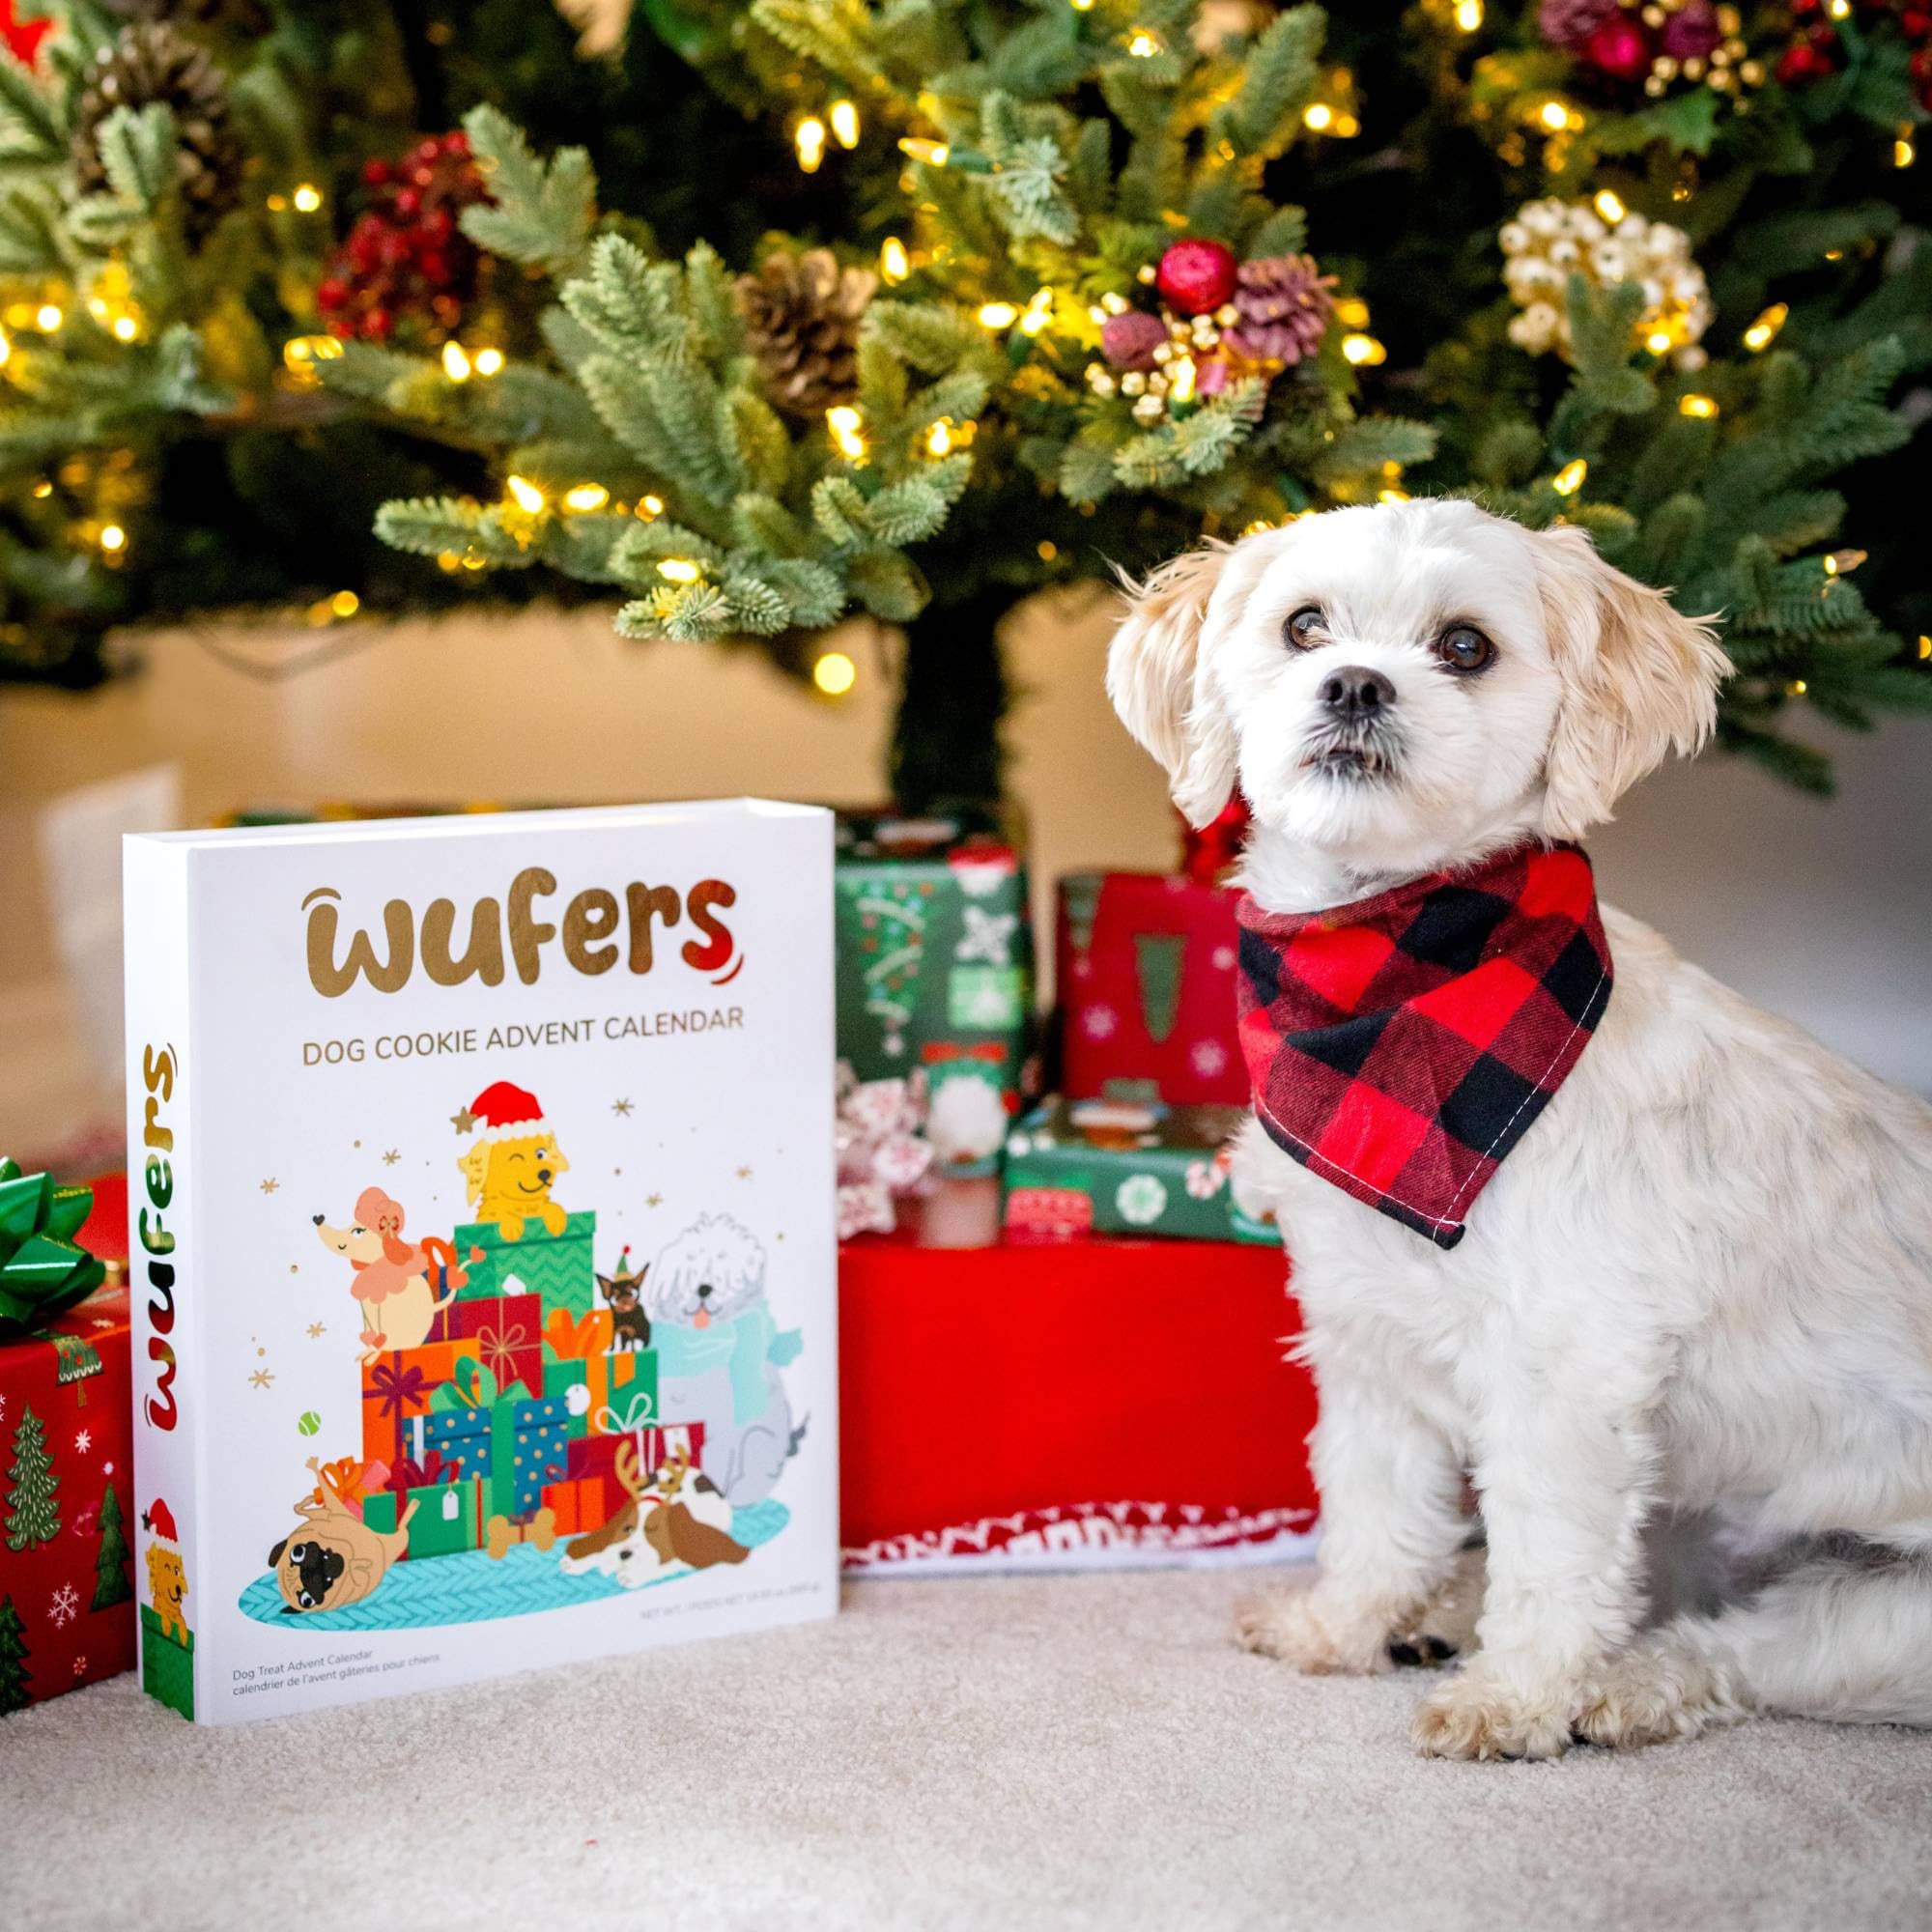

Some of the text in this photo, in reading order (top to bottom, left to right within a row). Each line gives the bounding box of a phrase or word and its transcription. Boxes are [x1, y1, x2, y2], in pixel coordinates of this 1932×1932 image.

[302, 867, 743, 998] wufers
[302, 1007, 744, 1065] DOG COOKIE ADVENT CALENDAR
[139, 1042, 178, 1432] wufers
[233, 1649, 373, 1681] Dog Treat Advent Calendar
[233, 1653, 440, 1695] calendrier de l'avent gâteries pour chiens
